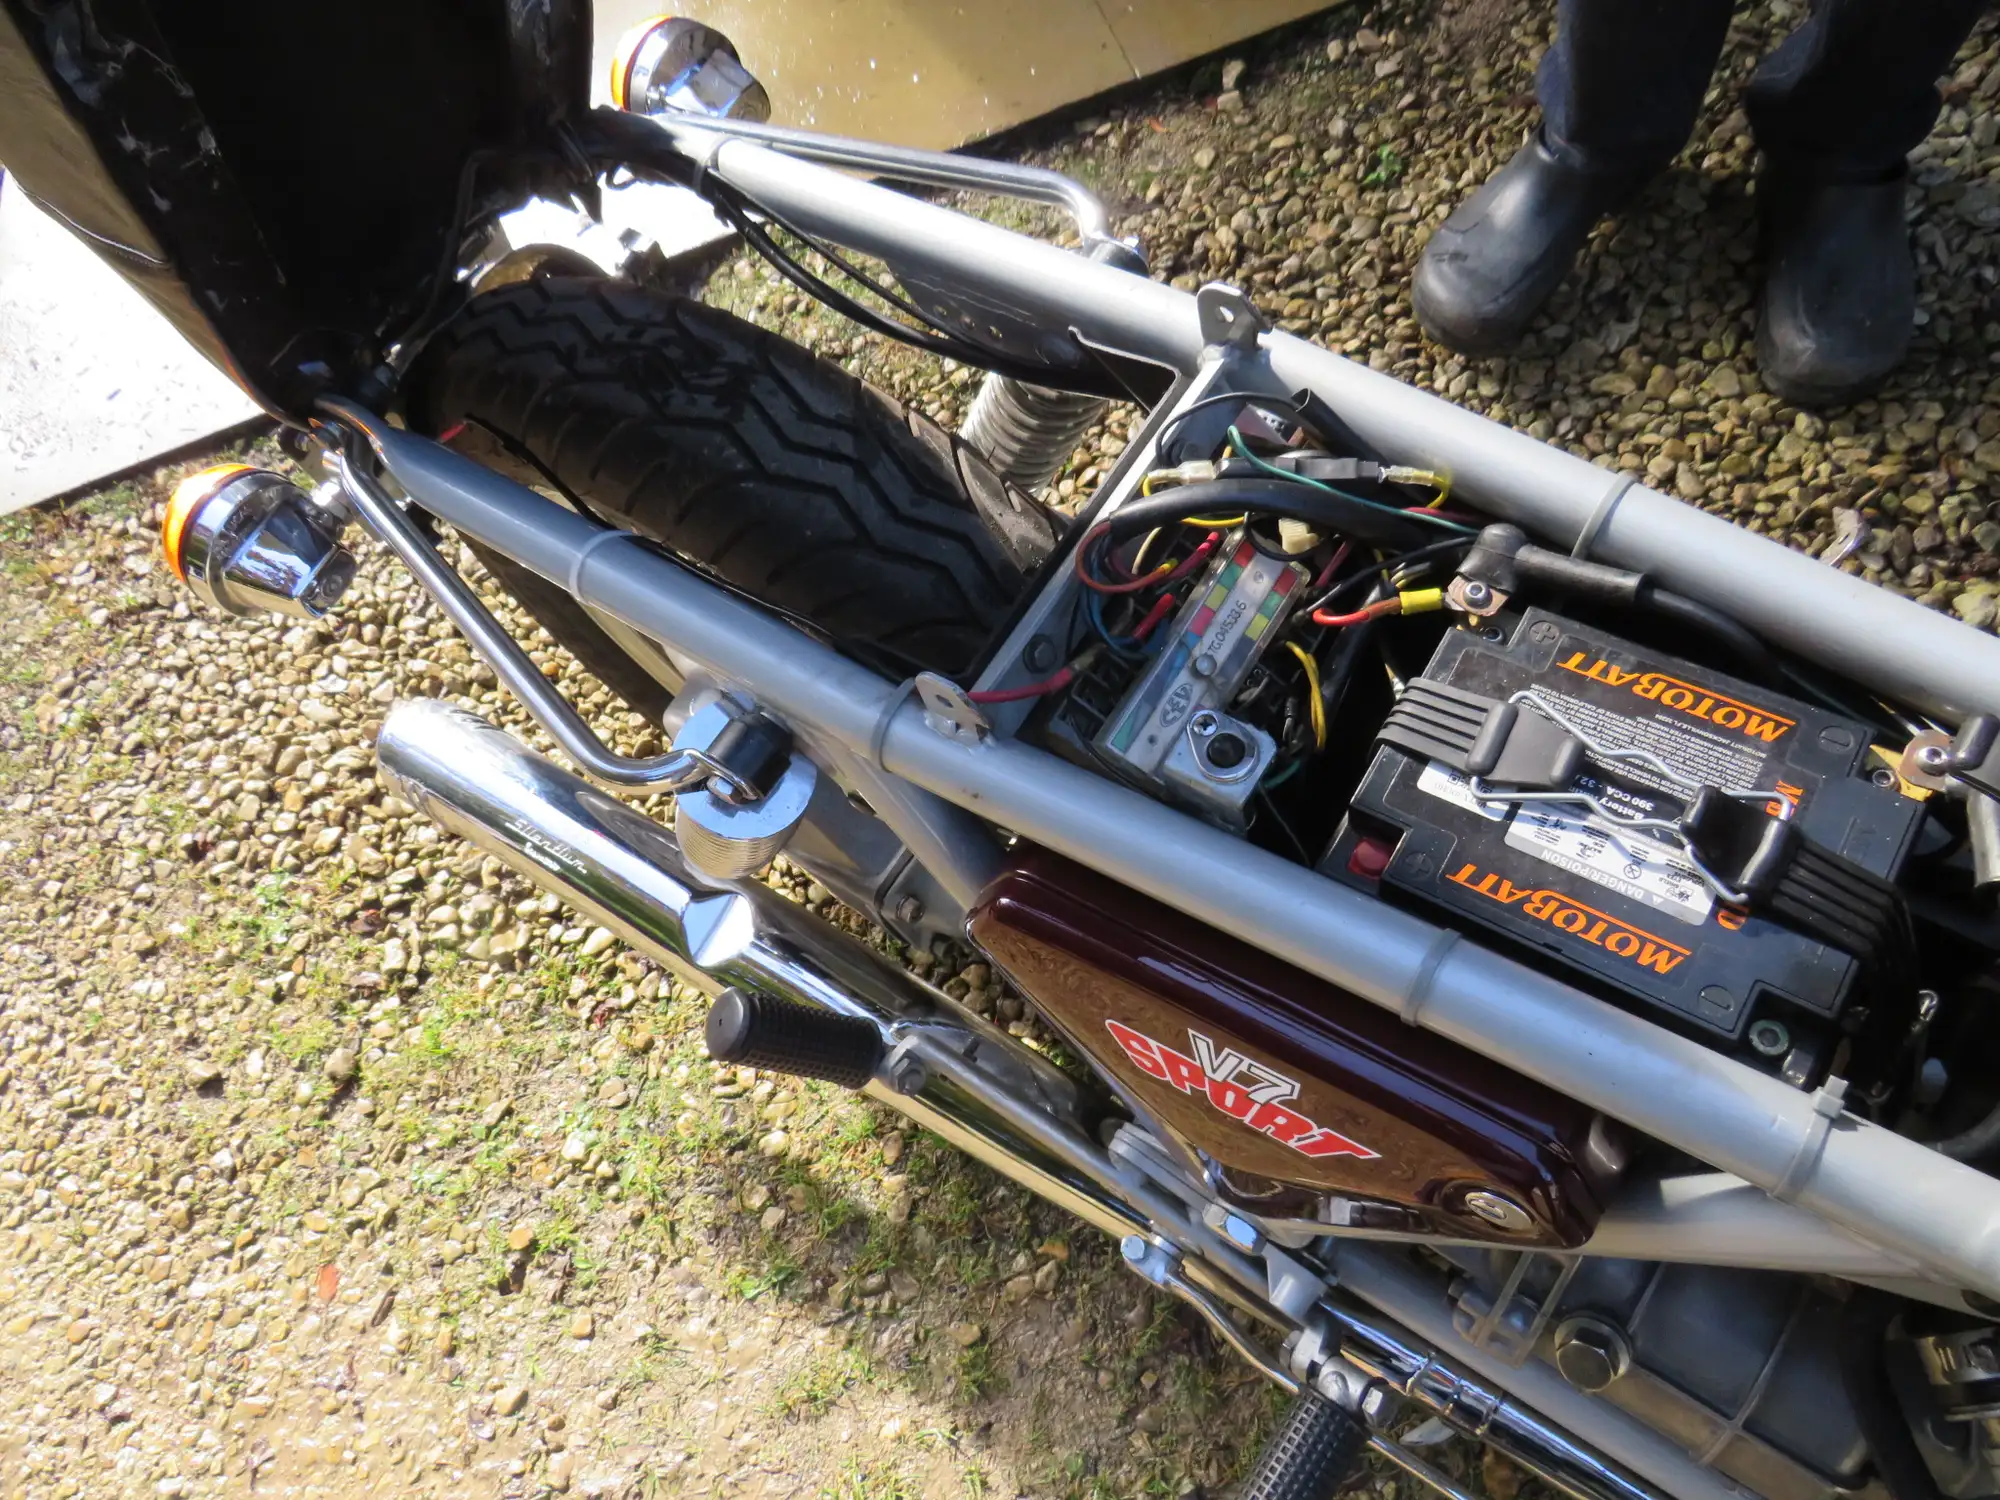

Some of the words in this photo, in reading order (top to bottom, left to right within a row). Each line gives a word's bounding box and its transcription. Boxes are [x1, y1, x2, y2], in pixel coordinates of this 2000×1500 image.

[1530, 682, 1551, 693] CAUSE
[1556, 652, 1796, 742] MOTOBATT
[1559, 693, 1596, 710] CALIFORNIA
[1604, 710, 1624, 721] STATE
[1624, 717, 1636, 725] THE
[1646, 726, 1670, 738] KNOWN
[1658, 737, 1685, 750] CANCER
[1670, 735, 1708, 752] CHEMICALS
[1675, 749, 1693, 759] LEAD
[1686, 747, 1708, 759] CAUSE
[1708, 749, 1730, 761] OTHER
[1693, 756, 1707, 765] AND
[1707, 762, 1725, 771] LEAD
[1730, 758, 1760, 772] CONTAIN
[1716, 759, 1758, 778] CALIFORNIA
[1725, 768, 1756, 783] CONTAIN
[1720, 773, 1737, 782] CALL
[1737, 779, 1753, 788] AND
[1604, 785, 1633, 803] CCA
[1597, 795, 1645, 821] Battery
[1631, 795, 1655, 811] 390
[1540, 848, 1644, 899] DANGER/POISON
[1446, 863, 1690, 974] MOTOBATT
[1188, 1028, 1301, 1105] V7
[1105, 1019, 1382, 1159] SPORT
